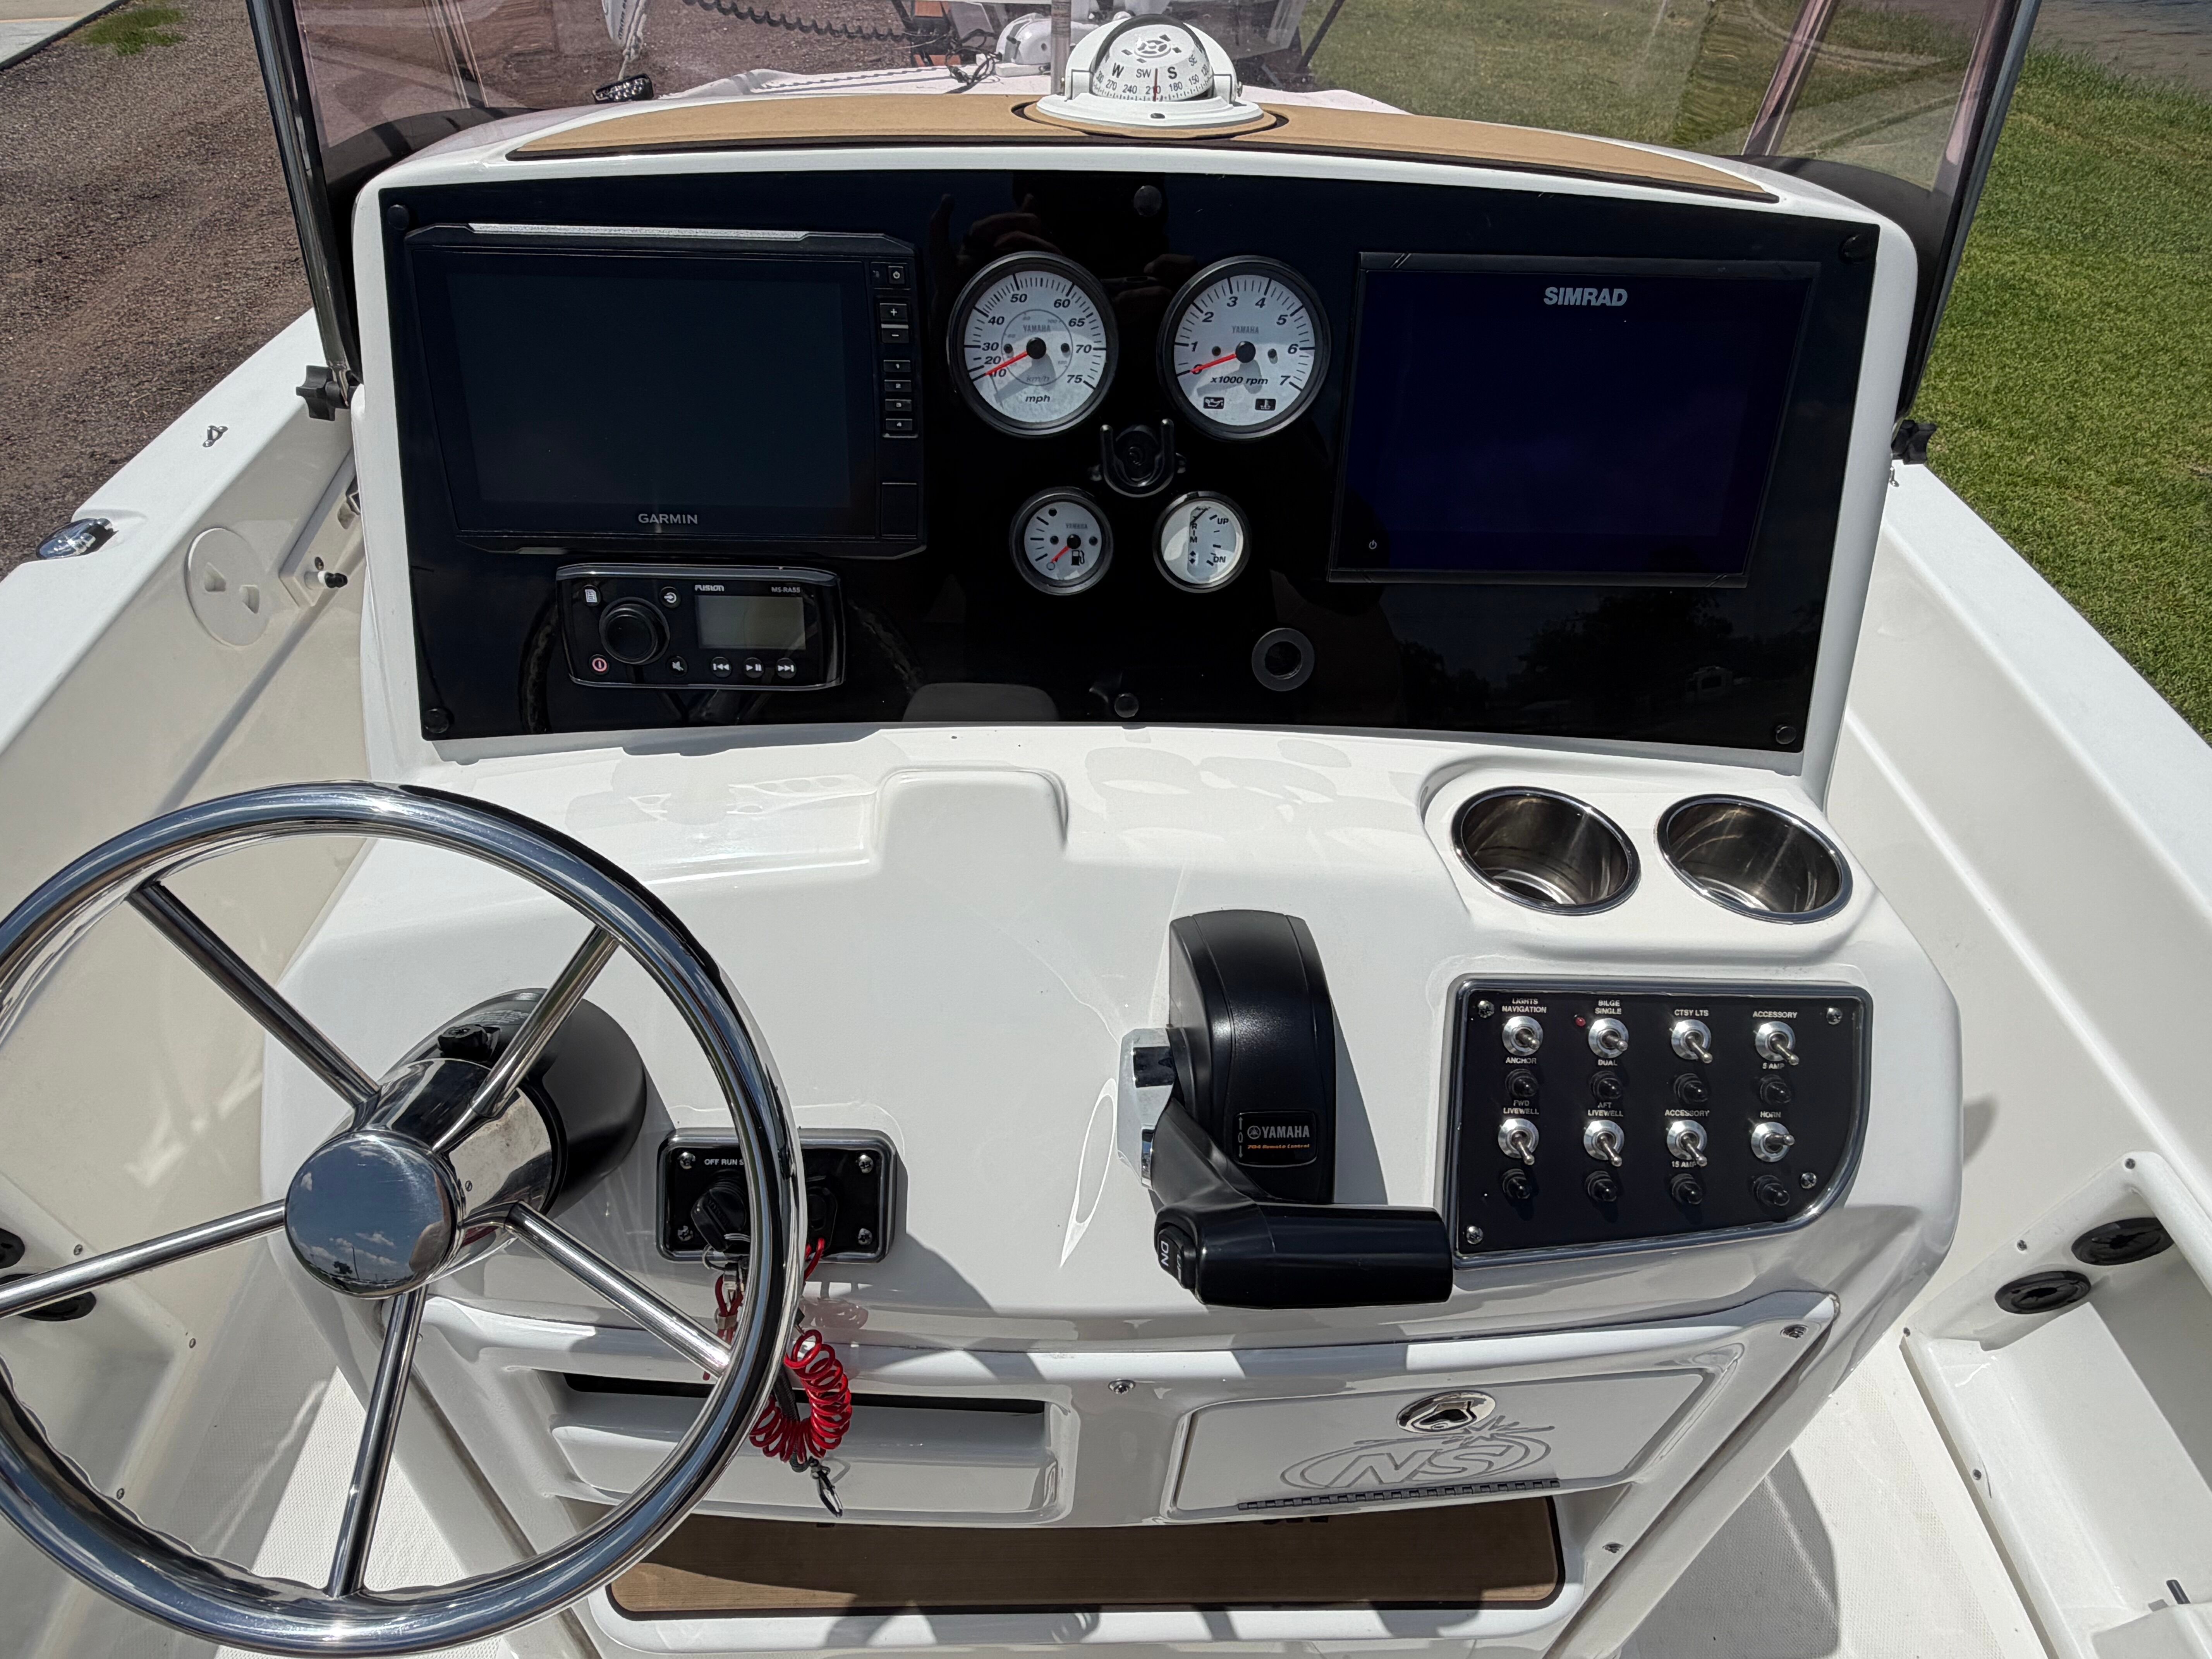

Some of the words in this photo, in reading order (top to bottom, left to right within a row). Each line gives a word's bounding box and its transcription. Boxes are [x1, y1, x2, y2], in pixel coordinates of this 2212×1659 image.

[1112, 62, 1124, 78] W
[1136, 69, 1151, 78] SW
[1168, 67, 1177, 79] S
[1106, 79, 1117, 90] 270
[1123, 84, 1137, 94] 240
[1169, 81, 1183, 91] 180
[1010, 293, 1027, 303] 50
[1544, 287, 1628, 306] SIMRAD
[1053, 299, 1070, 308] 60
[1227, 297, 1238, 307] 3
[1255, 298, 1265, 308] 4
[988, 316, 1005, 325] 40
[1202, 312, 1214, 322] 2
[1276, 314, 1288, 325] 5
[1068, 318, 1085, 327] 65
[1231, 326, 1259, 334] YAMAHA
[982, 342, 999, 351] 30
[1075, 345, 1092, 353] 70
[1191, 342, 1198, 352] 1
[1288, 344, 1298, 354] 6
[984, 356, 1001, 364] 20
[1067, 375, 1083, 383] 75
[1245, 376, 1268, 385] rpm
[1279, 376, 1290, 386] 7
[1025, 395, 1050, 403] mph
[638, 514, 698, 524] GARMIN
[1262, 1125, 1310, 1139] YAMAHA
[1161, 1240, 1169, 1267] DN
